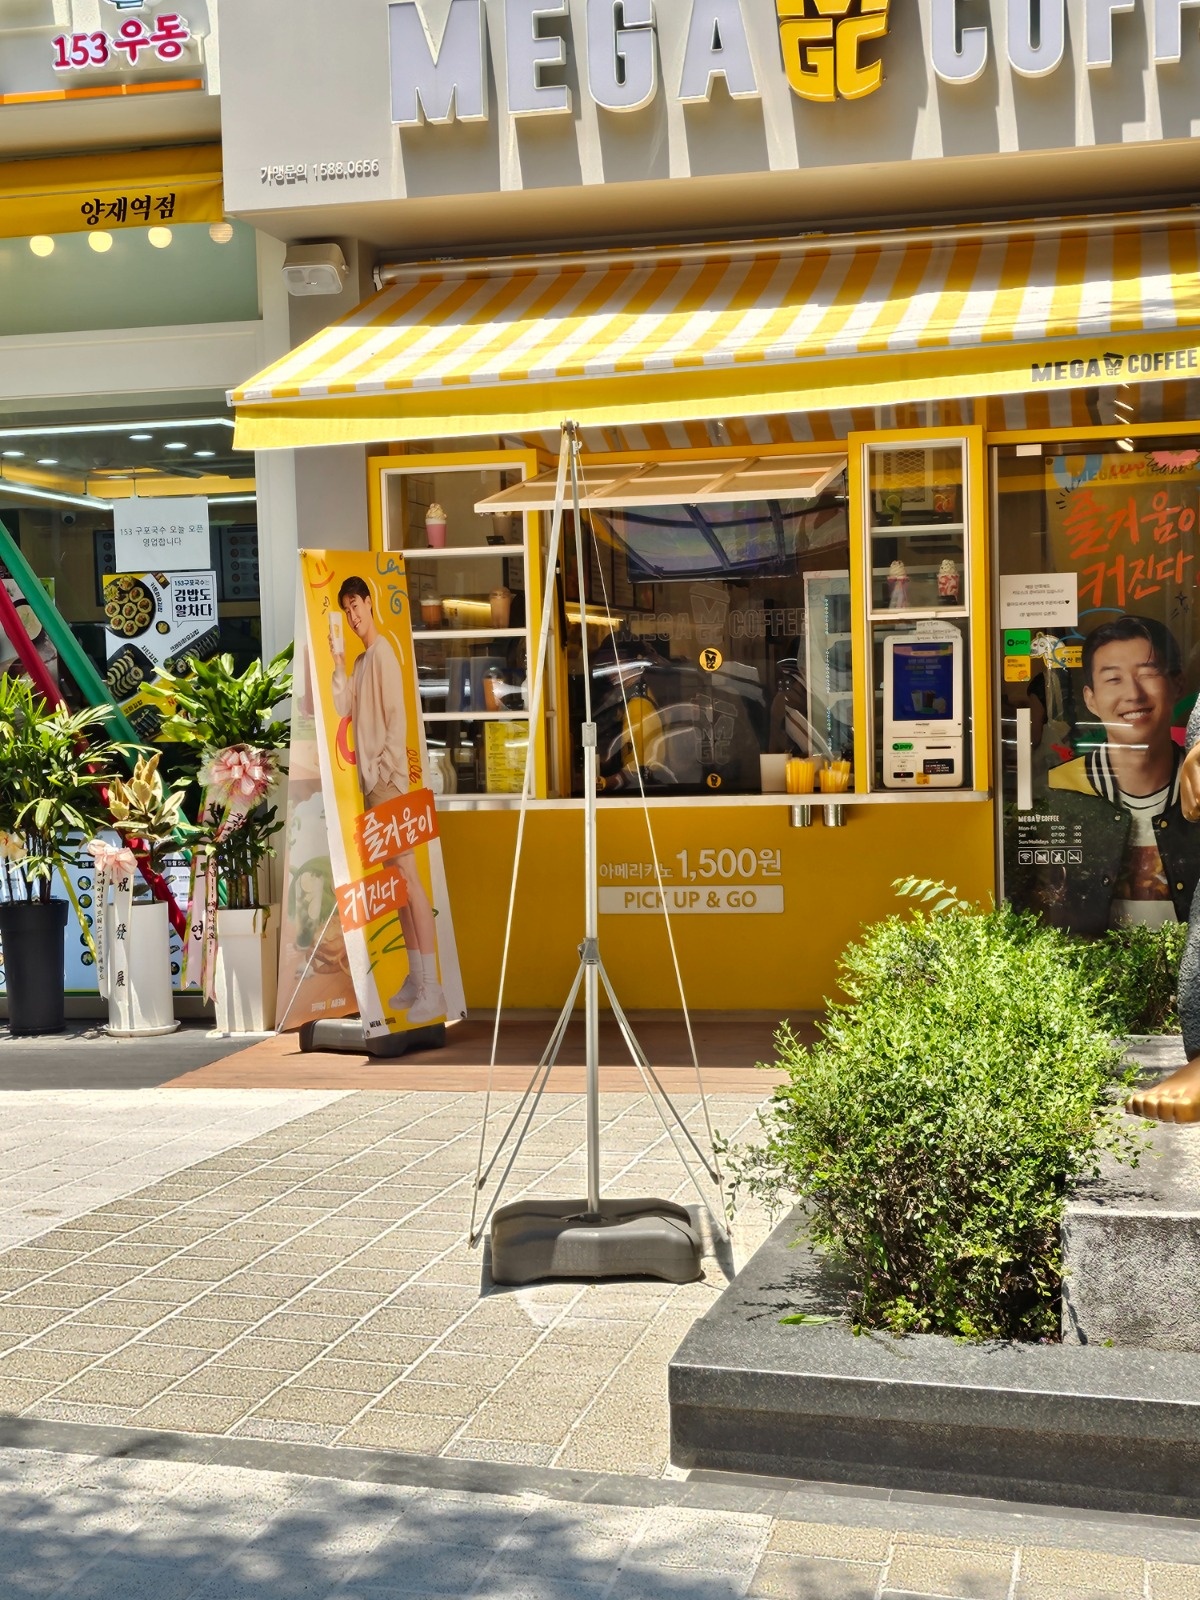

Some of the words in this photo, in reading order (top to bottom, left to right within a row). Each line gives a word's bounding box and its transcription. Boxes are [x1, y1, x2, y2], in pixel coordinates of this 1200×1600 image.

[387, 0, 761, 126] MEGA
[260, 163, 308, 182] 가맹문의
[80, 192, 178, 227] 양재역점
[1031, 358, 1102, 383] MEGA
[1127, 349, 1198, 374] COFFEE
[120, 528, 133, 536] 153
[135, 525, 167, 536] 구포국수
[169, 525, 185, 535] 오늘
[188, 524, 204, 534] 오픈
[1062, 490, 1200, 560] 즐거움이
[142, 537, 182, 548] 영업합니다
[1078, 549, 1194, 608] 커진다
[174, 588, 212, 603] 김밥도
[175, 603, 213, 618] 알차다
[362, 805, 434, 863] 즐거움이
[1018, 815, 1035, 823] MEGA
[599, 862, 673, 880] 아메리카노
[676, 848, 782, 881] 1,500원
[343, 875, 400, 924] 커진다
[624, 891, 668, 909] PICK
[674, 891, 700, 909] UP
[706, 891, 721, 908] &
[726, 890, 757, 908] GO
